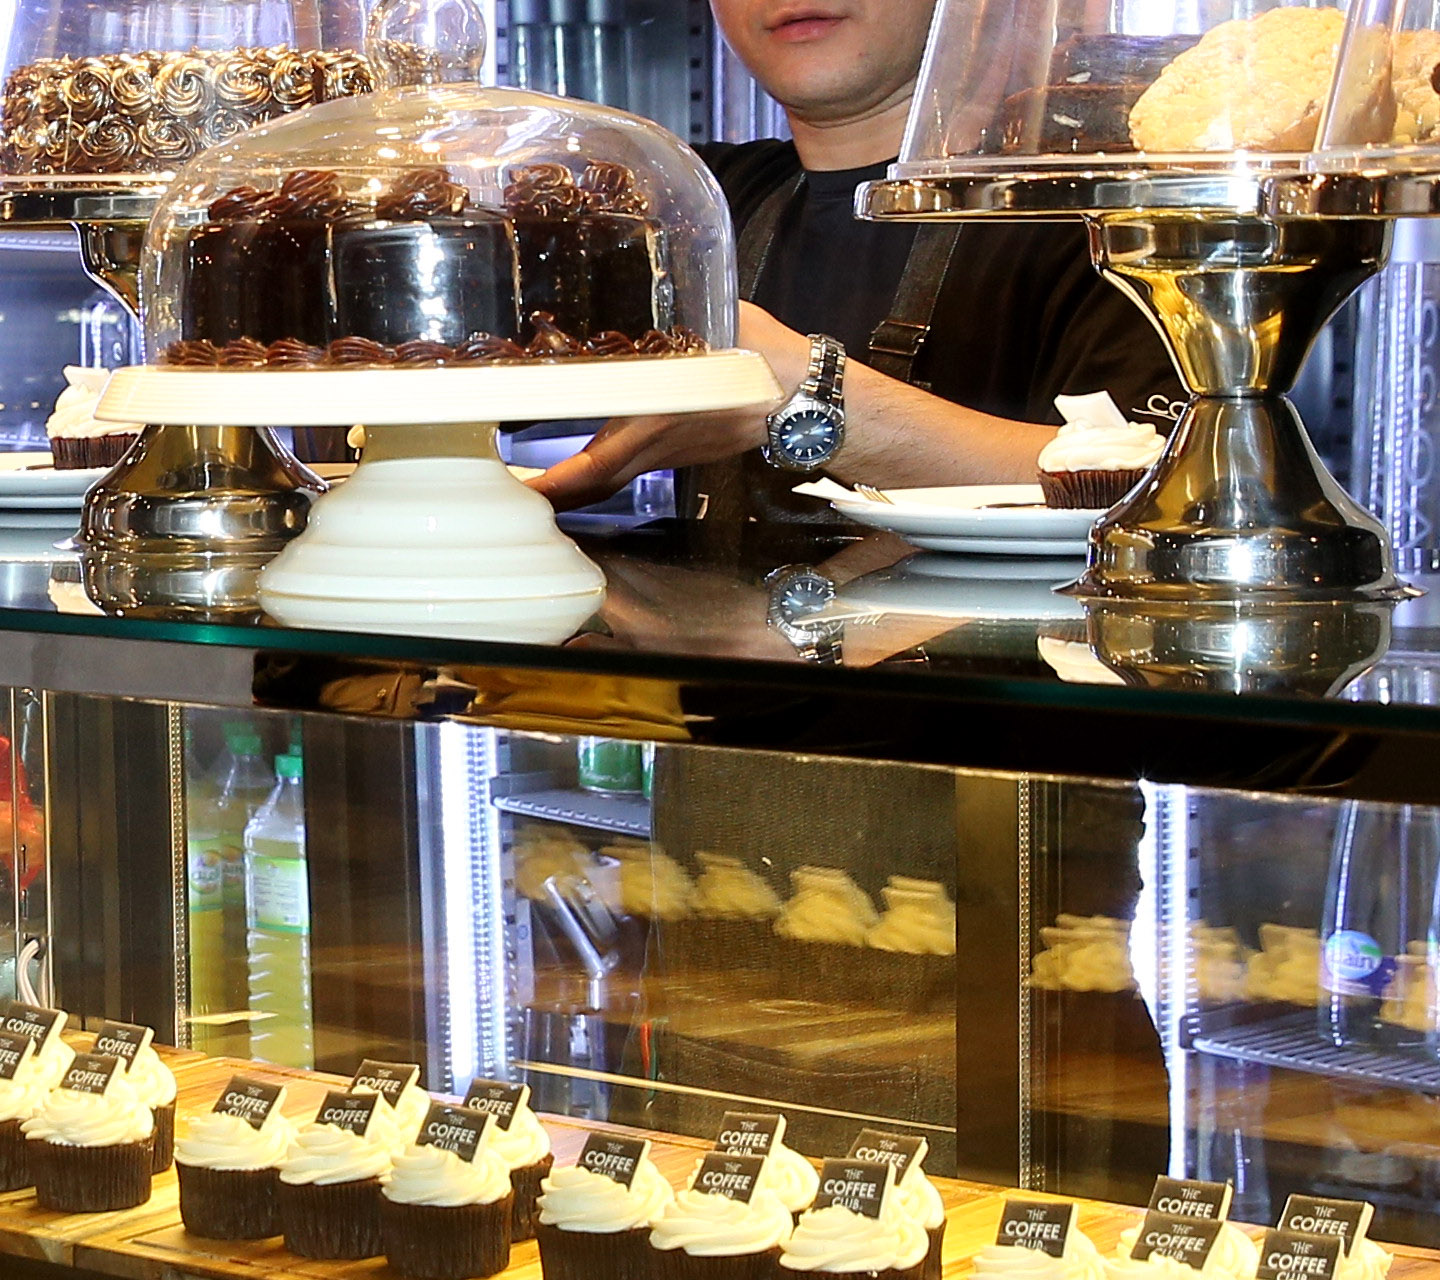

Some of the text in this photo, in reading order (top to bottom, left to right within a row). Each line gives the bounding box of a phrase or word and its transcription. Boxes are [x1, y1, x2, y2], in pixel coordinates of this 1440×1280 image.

[98, 1037, 137, 1056] COFFEE
[68, 1069, 107, 1087] COFFEE
[225, 1092, 269, 1114] COFFEE
[324, 1108, 369, 1123] COFFEE
[428, 1122, 476, 1144] COFFEE
[720, 1130, 769, 1148] COFFEE
[879, 1139, 898, 1151] THE
[585, 1150, 634, 1173] COFFEE
[702, 1171, 752, 1190] COFFEE
[844, 1168, 864, 1180] THE
[823, 1179, 876, 1198] COFFEE
[1181, 1187, 1201, 1200] THE
[1026, 1208, 1047, 1221] THE
[1157, 1197, 1214, 1219] COFFEE
[1314, 1205, 1336, 1218] THE
[1005, 1220, 1061, 1239] COFFEE
[1171, 1223, 1194, 1234] THE
[1145, 1232, 1206, 1252] COFFEE
[1291, 1241, 1313, 1254] THE
[1267, 1252, 1328, 1275] COFFEE
